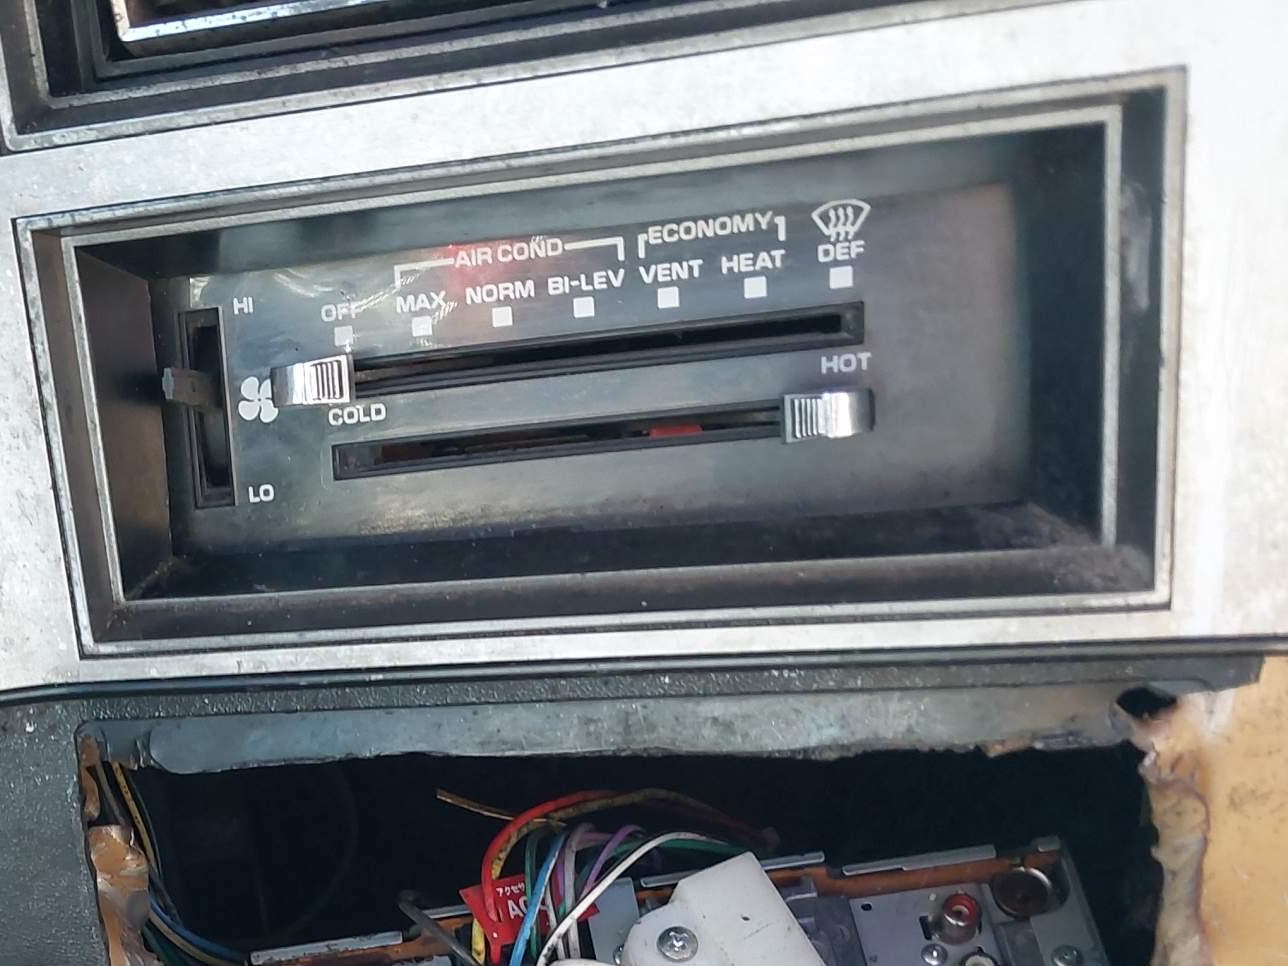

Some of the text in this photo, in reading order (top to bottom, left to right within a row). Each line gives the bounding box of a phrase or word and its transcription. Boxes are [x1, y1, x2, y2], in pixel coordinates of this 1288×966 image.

[647, 211, 772, 244] ECONOMY
[454, 238, 563, 268] AIR COND
[320, 240, 866, 322] OFF MAX NORM BI-LEV VENT HEAT DEF
[233, 297, 254, 315] HI
[821, 352, 871, 374] HOT
[328, 403, 387, 426] COLD
[248, 484, 275, 503] LO
